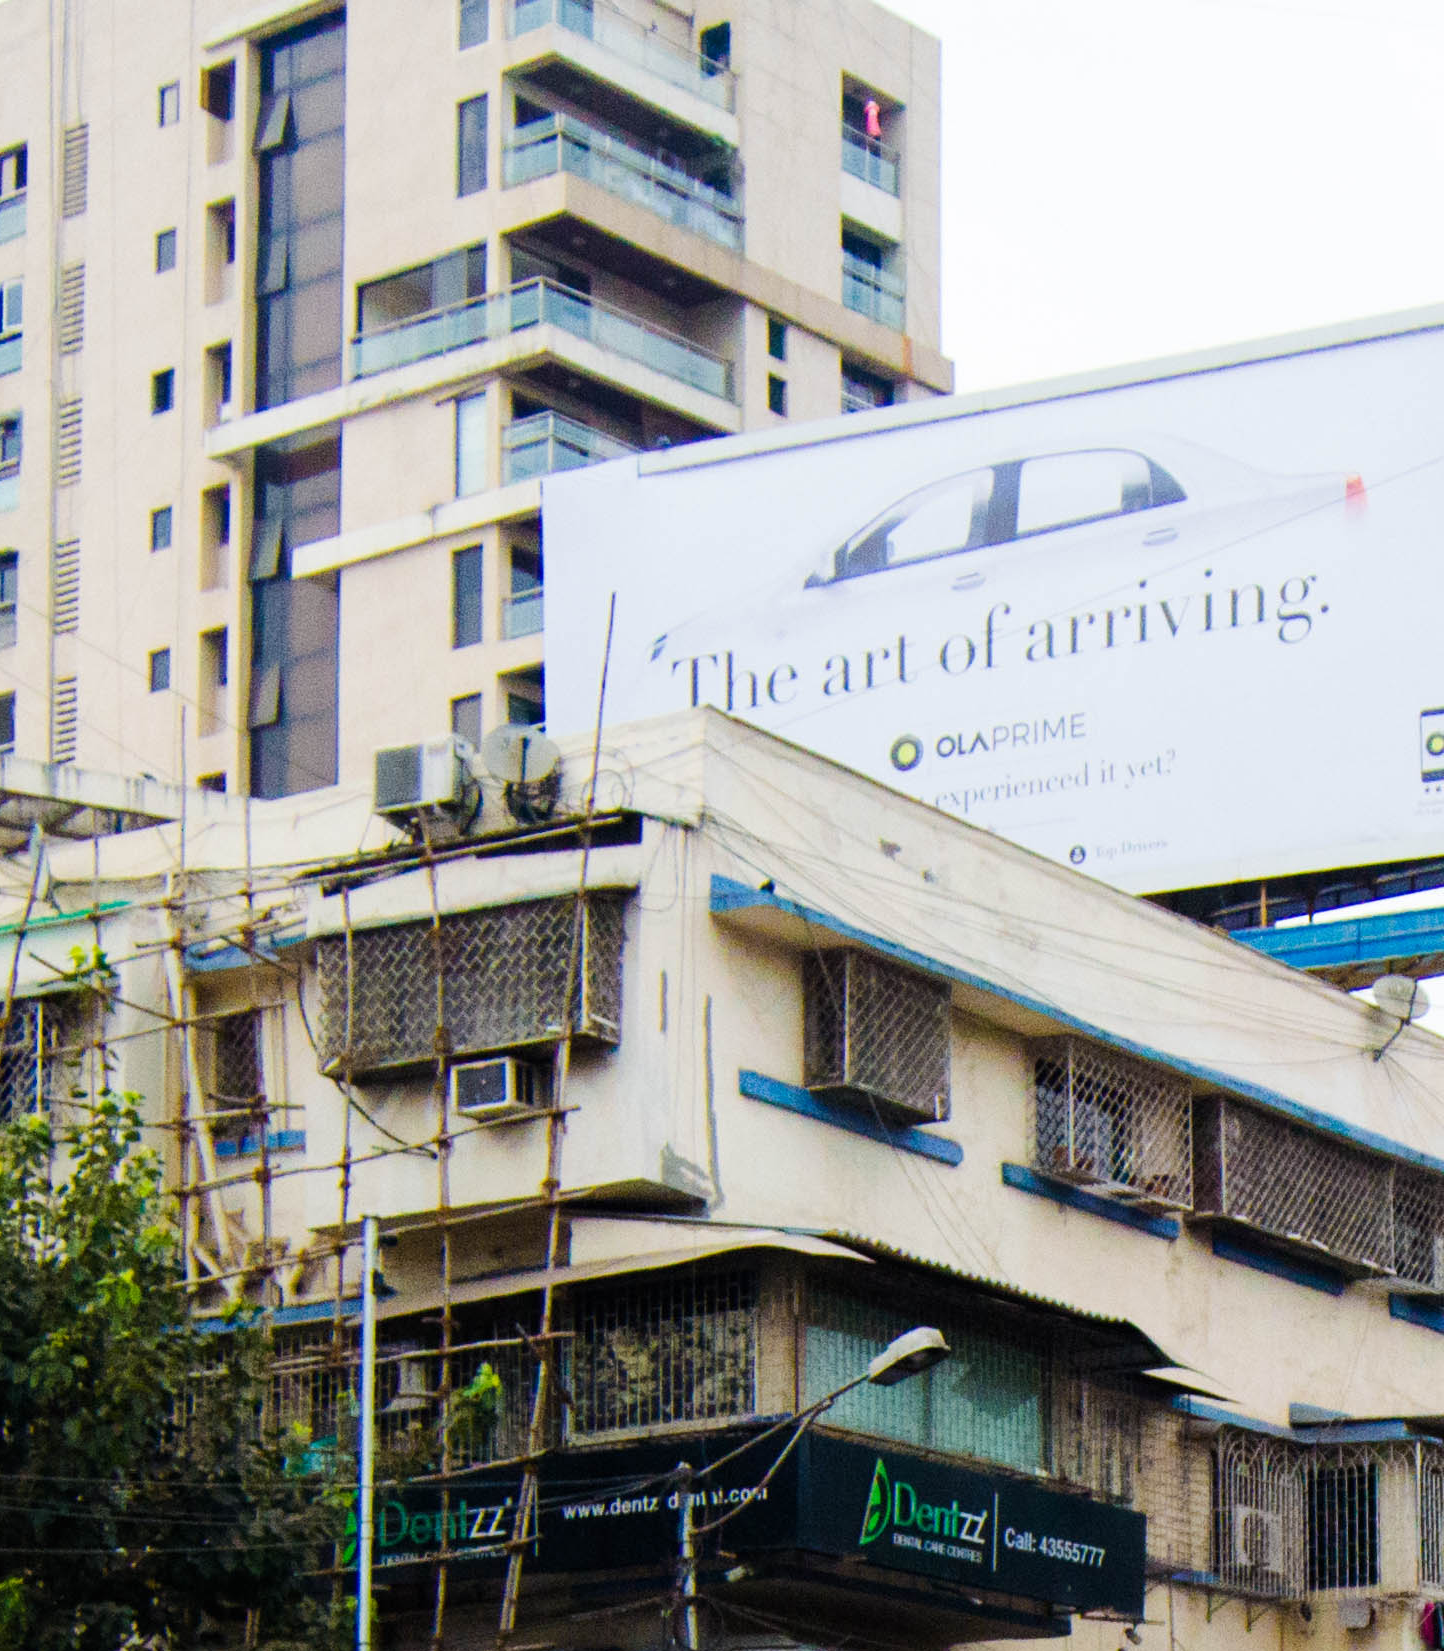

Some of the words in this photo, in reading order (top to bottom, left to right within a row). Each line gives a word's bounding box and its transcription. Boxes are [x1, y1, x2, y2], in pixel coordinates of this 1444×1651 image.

[672, 651, 799, 712] The
[822, 634, 912, 697] art
[939, 602, 1012, 676] of
[1024, 568, 1331, 663] arriving.
[934, 760, 1090, 814] experienced
[1100, 759, 1116, 785] it
[1123, 748, 1178, 790] yet?
[892, 1479, 989, 1546] Dentzz
[1003, 1526, 1037, 1554] Call:
[1039, 1535, 1107, 1569] 43555777
